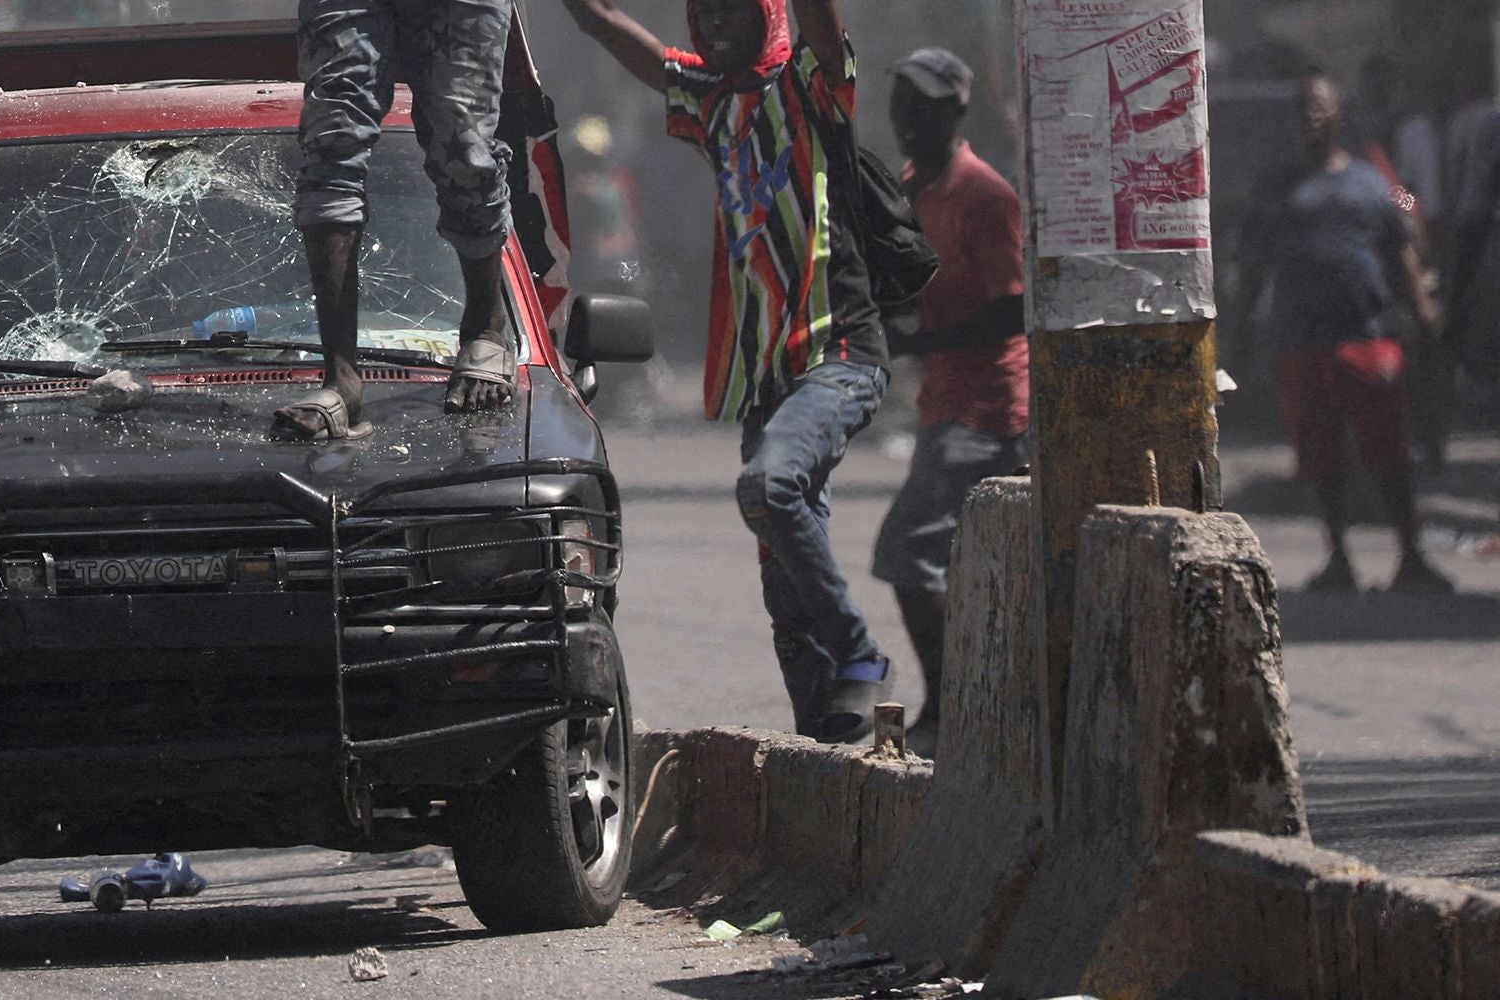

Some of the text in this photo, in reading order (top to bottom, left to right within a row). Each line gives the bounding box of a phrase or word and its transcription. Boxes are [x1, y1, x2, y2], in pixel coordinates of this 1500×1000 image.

[1061, 3, 1078, 13] LE
[1114, 9, 1190, 55] SPECIAL
[1122, 22, 1190, 63] IMPRESSION
[1117, 30, 1198, 79] CALENDRIER
[75, 555, 228, 585] TOYOTA
